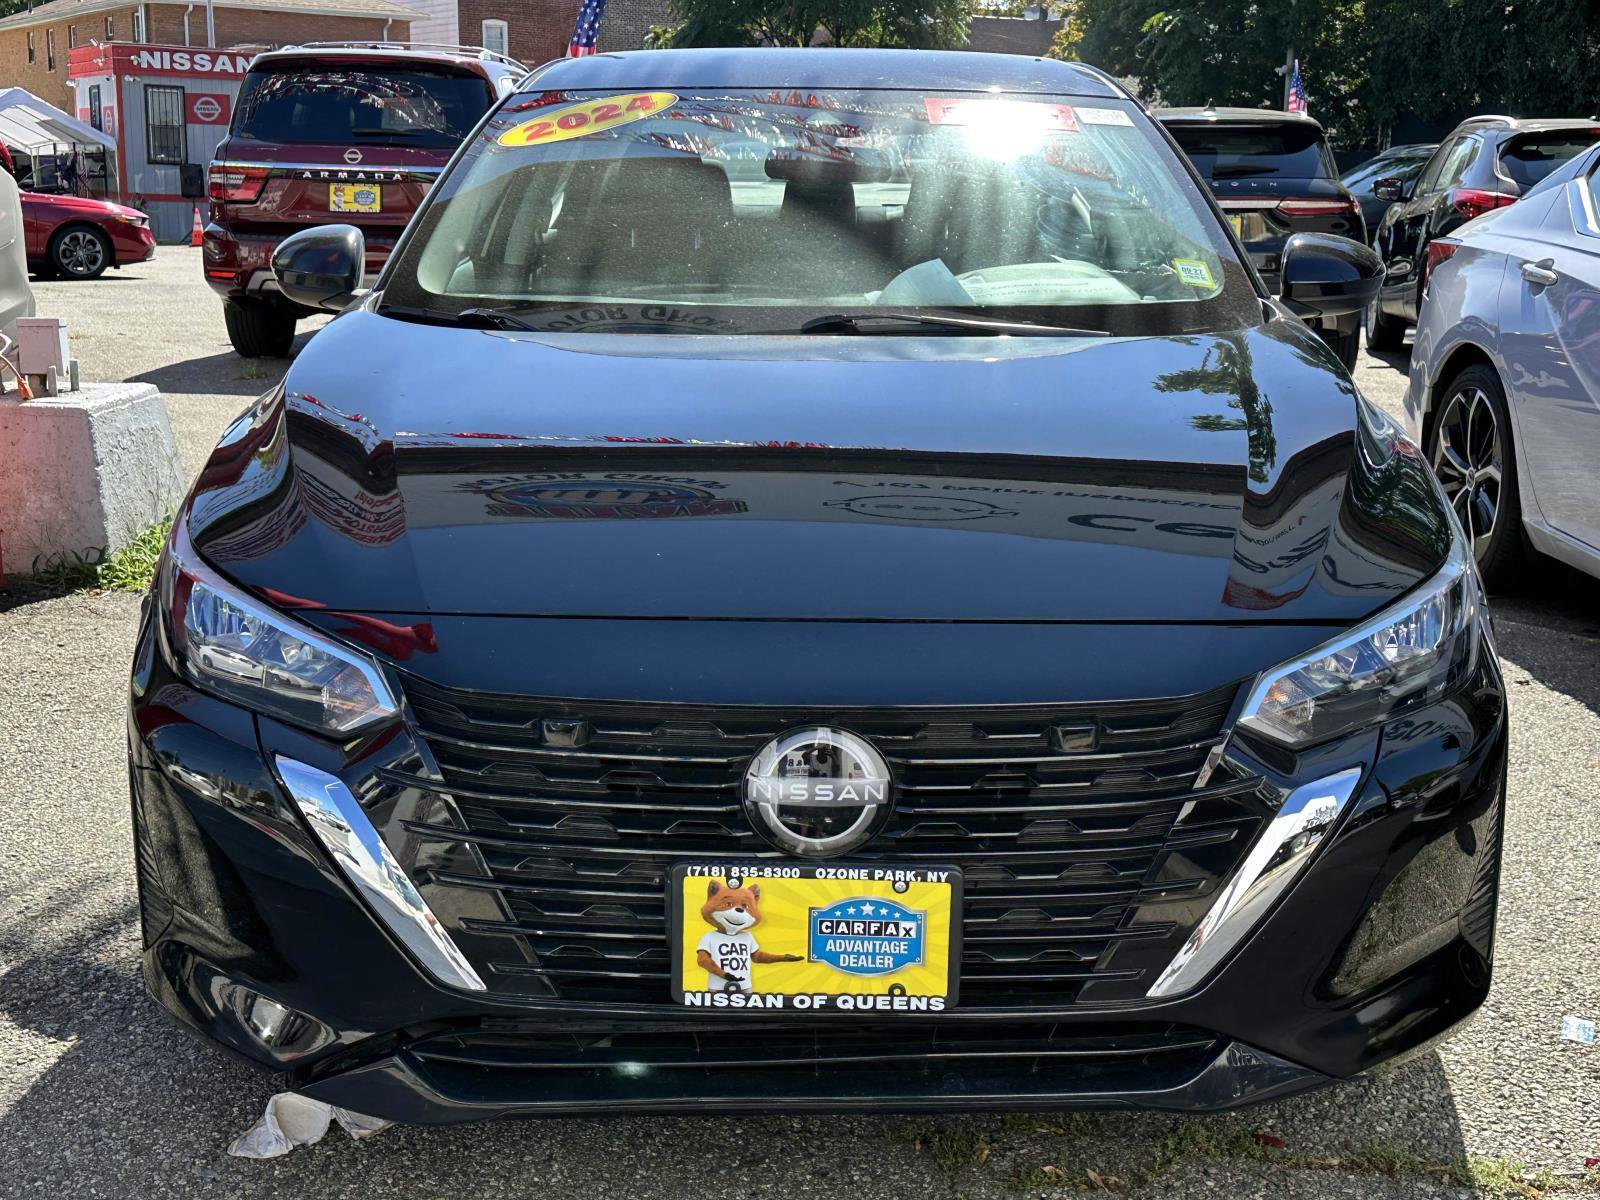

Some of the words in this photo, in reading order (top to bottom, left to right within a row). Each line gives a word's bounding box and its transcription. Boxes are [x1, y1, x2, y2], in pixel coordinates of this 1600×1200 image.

[139, 50, 251, 74] NISSAN
[523, 95, 658, 142] 2024
[302, 171, 403, 181] ARMADA
[752, 779, 884, 801] NISSAN
[687, 865, 725, 877] (718)
[731, 866, 800, 879] 835-8300
[815, 867, 869, 880] OZONE
[874, 869, 922, 882] PARK,
[927, 871, 949, 883] NY
[820, 920, 914, 938] CARFAX
[718, 942, 749, 957] CAR
[825, 938, 909, 954] ADVANTAGE
[719, 957, 749, 972] FOX
[839, 953, 894, 969] DEALER
[684, 992, 784, 1009] NISSAN
[792, 995, 828, 1010] OF
[836, 996, 945, 1011] QUEENS
